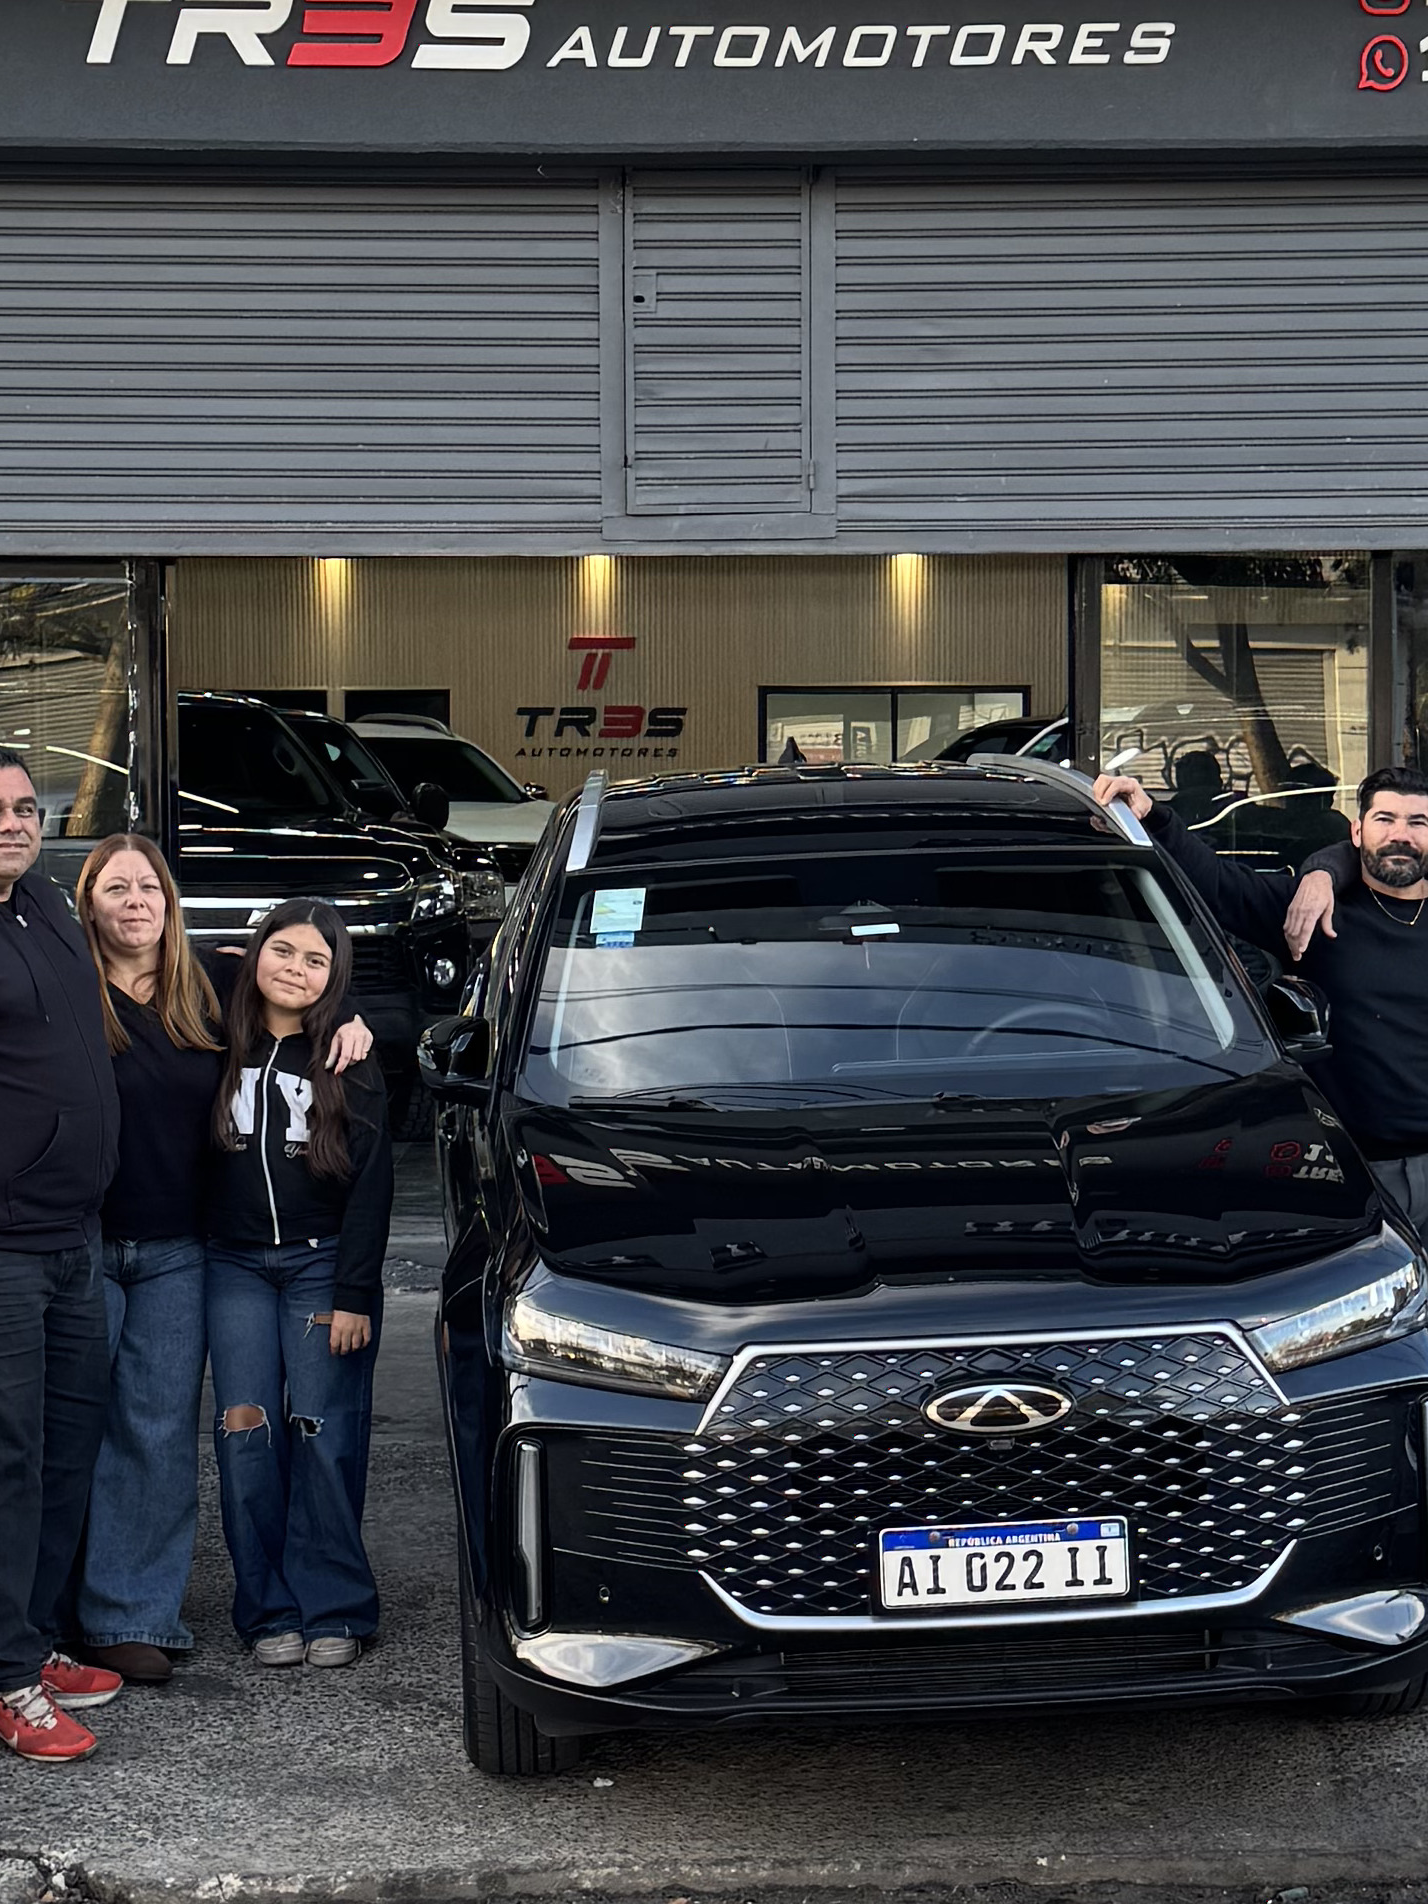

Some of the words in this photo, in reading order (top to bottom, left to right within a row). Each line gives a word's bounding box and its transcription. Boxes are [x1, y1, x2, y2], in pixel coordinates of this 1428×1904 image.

[545, 22, 1177, 68] AUTOMOTORES
[515, 747, 681, 759] AUTOMOTORES
[1005, 1532, 1061, 1545] ARGENTINA
[896, 1554, 947, 1597] AI
[965, 1549, 1045, 1593] 022
